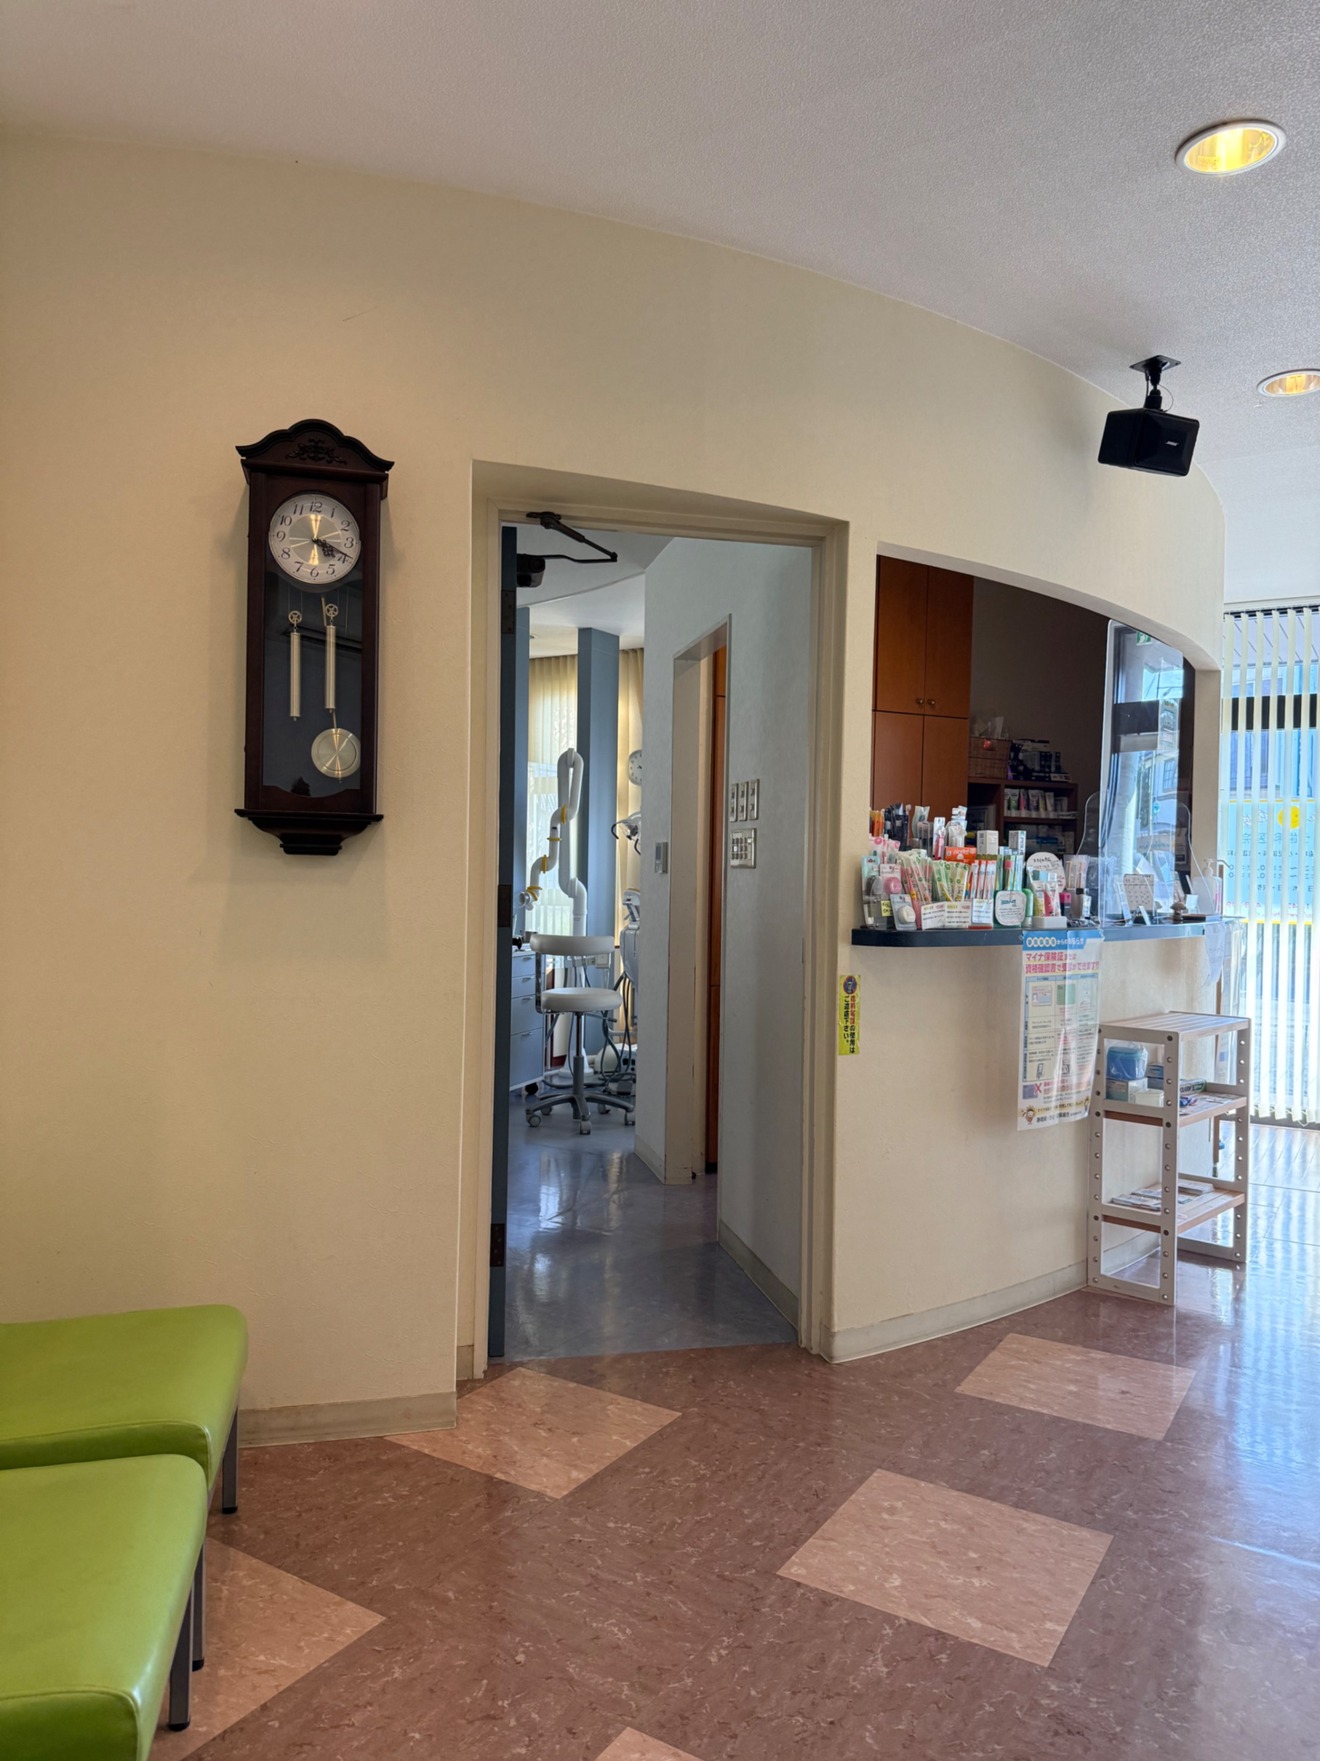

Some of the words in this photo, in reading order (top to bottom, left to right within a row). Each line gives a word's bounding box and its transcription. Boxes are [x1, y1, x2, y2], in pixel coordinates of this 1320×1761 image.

[293, 504, 304, 515] 11
[309, 501, 323, 513] 12
[280, 515, 292, 526] 10
[340, 520, 351, 531] 2
[276, 530, 286, 542] 9
[344, 537, 354, 549] 3
[280, 548, 291, 560] 8
[294, 561, 304, 573] 7
[310, 566, 320, 578] 6
[326, 564, 336, 576] 5
